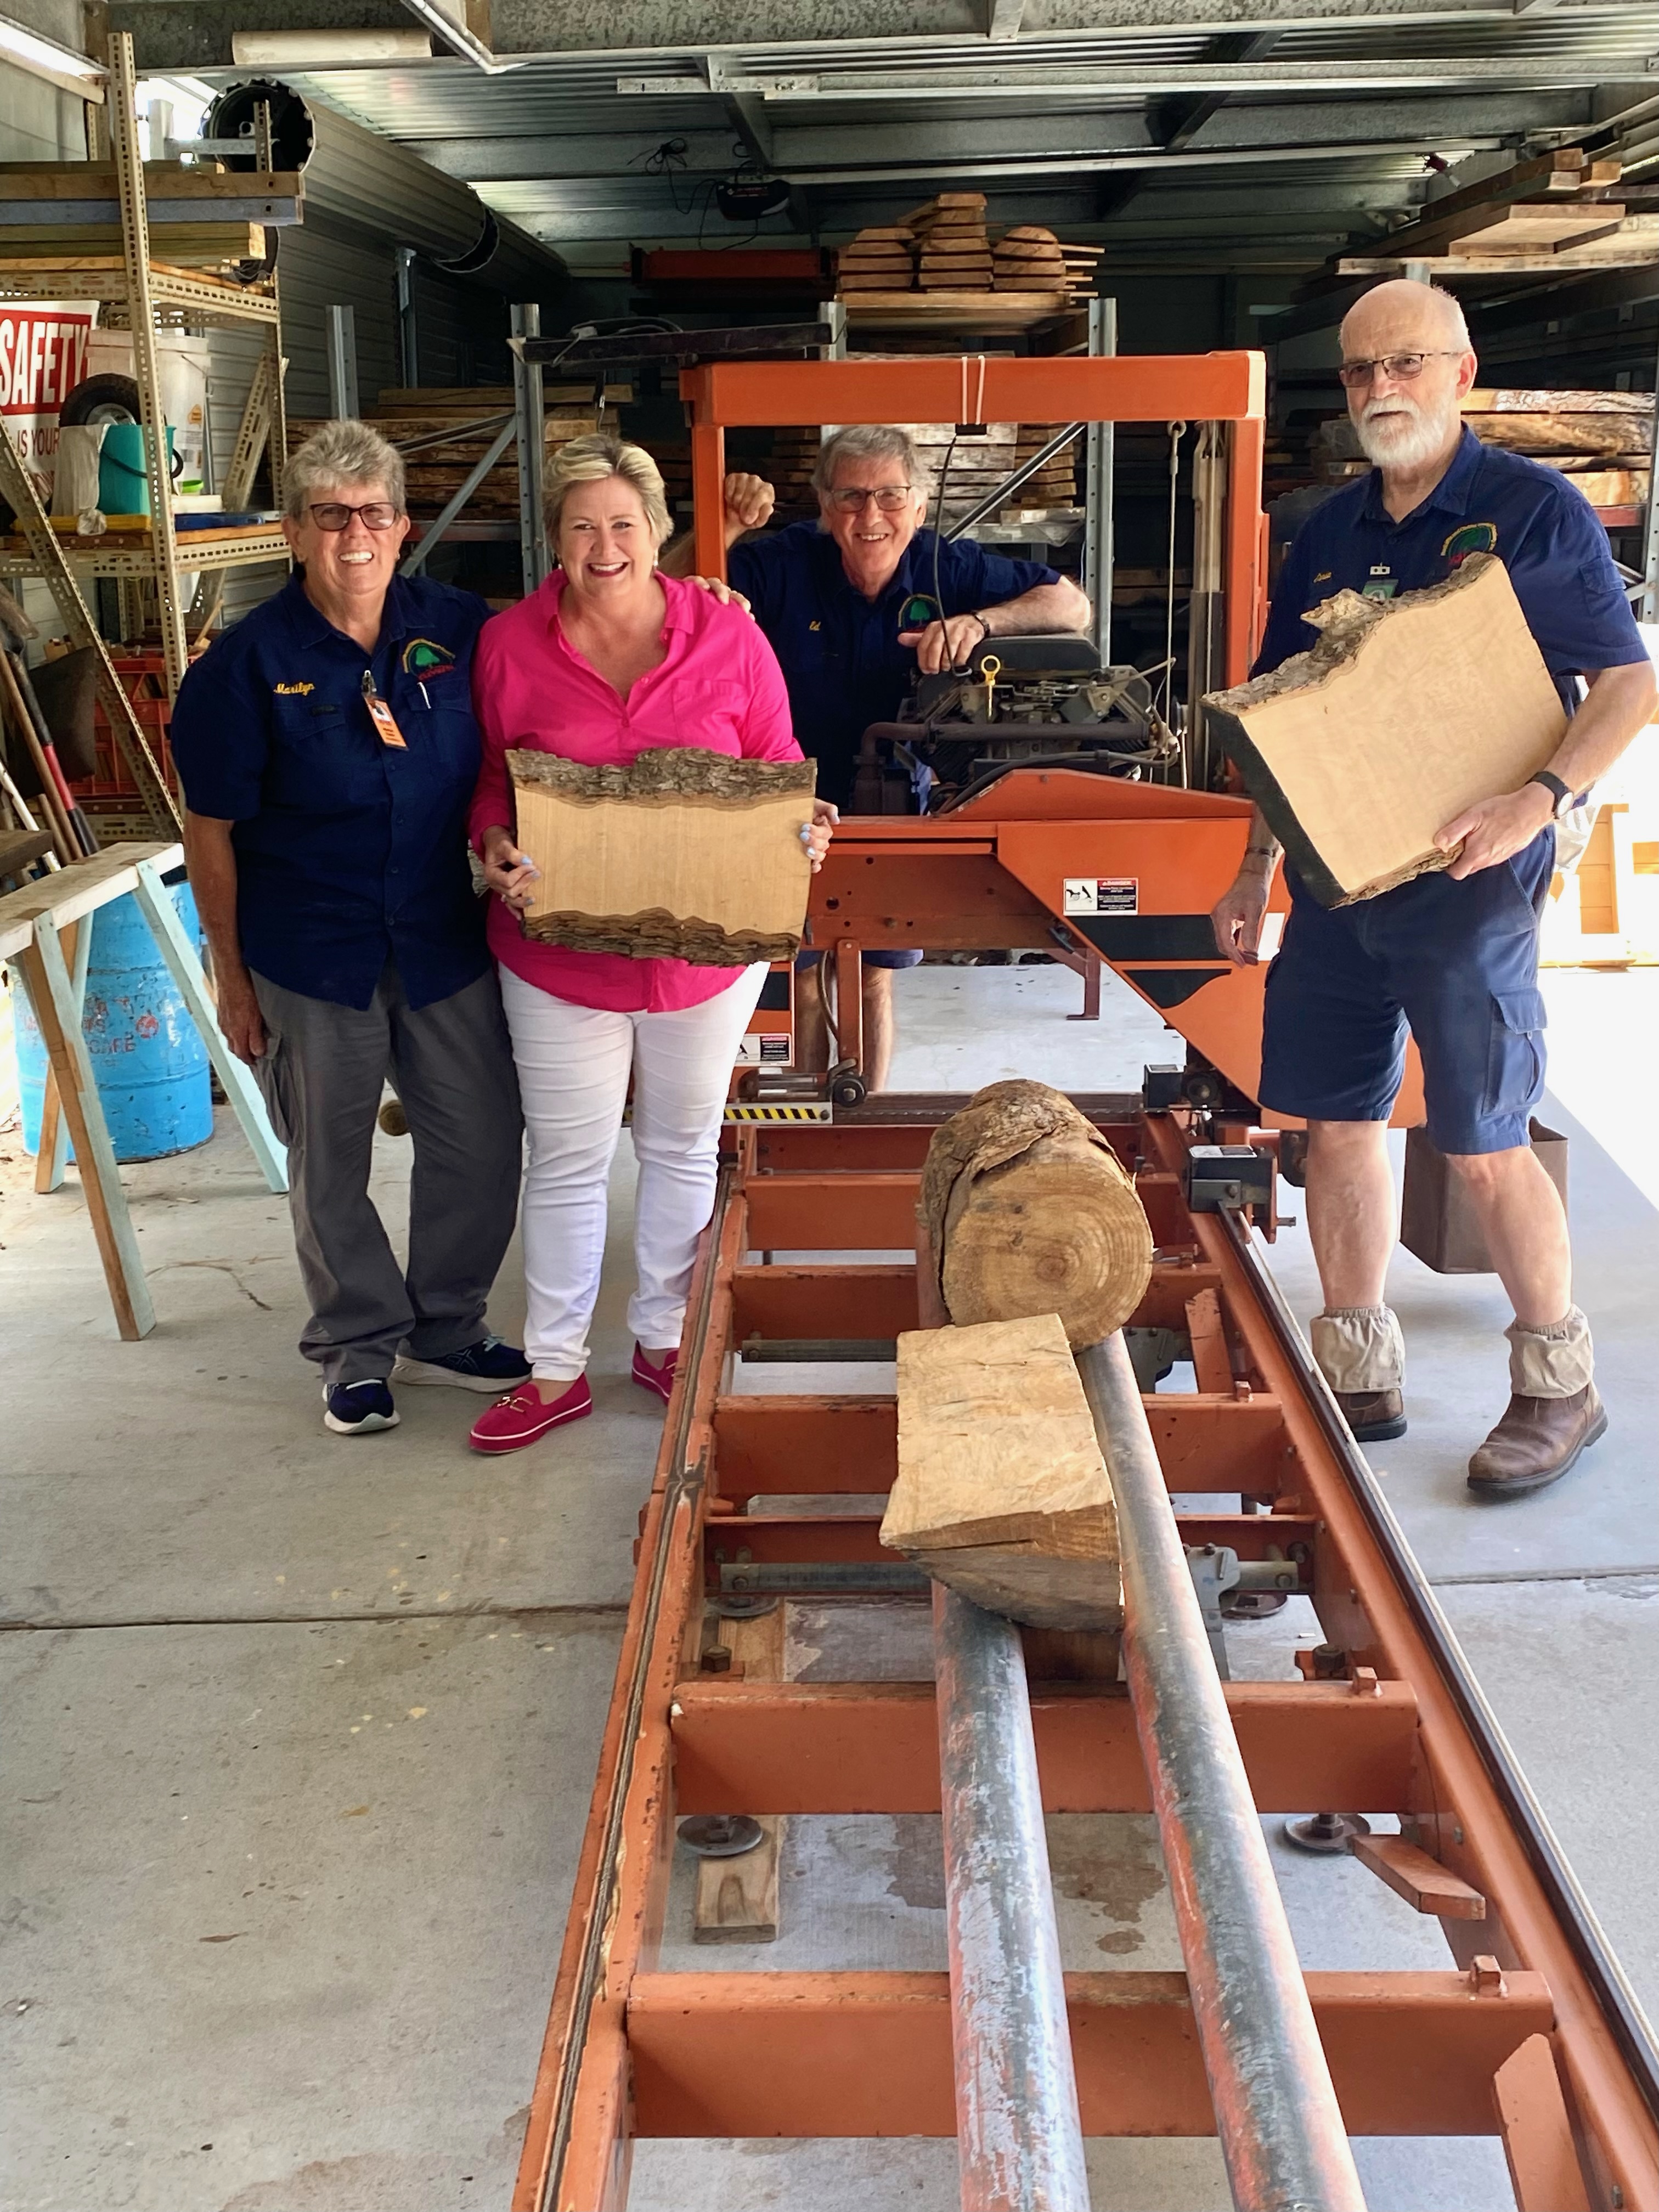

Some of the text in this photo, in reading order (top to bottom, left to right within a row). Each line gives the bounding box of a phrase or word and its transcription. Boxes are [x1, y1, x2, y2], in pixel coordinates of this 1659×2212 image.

[0, 318, 88, 406] SAFETY
[18, 427, 60, 458] IS YOUR
[273, 682, 315, 696] Marilyn
